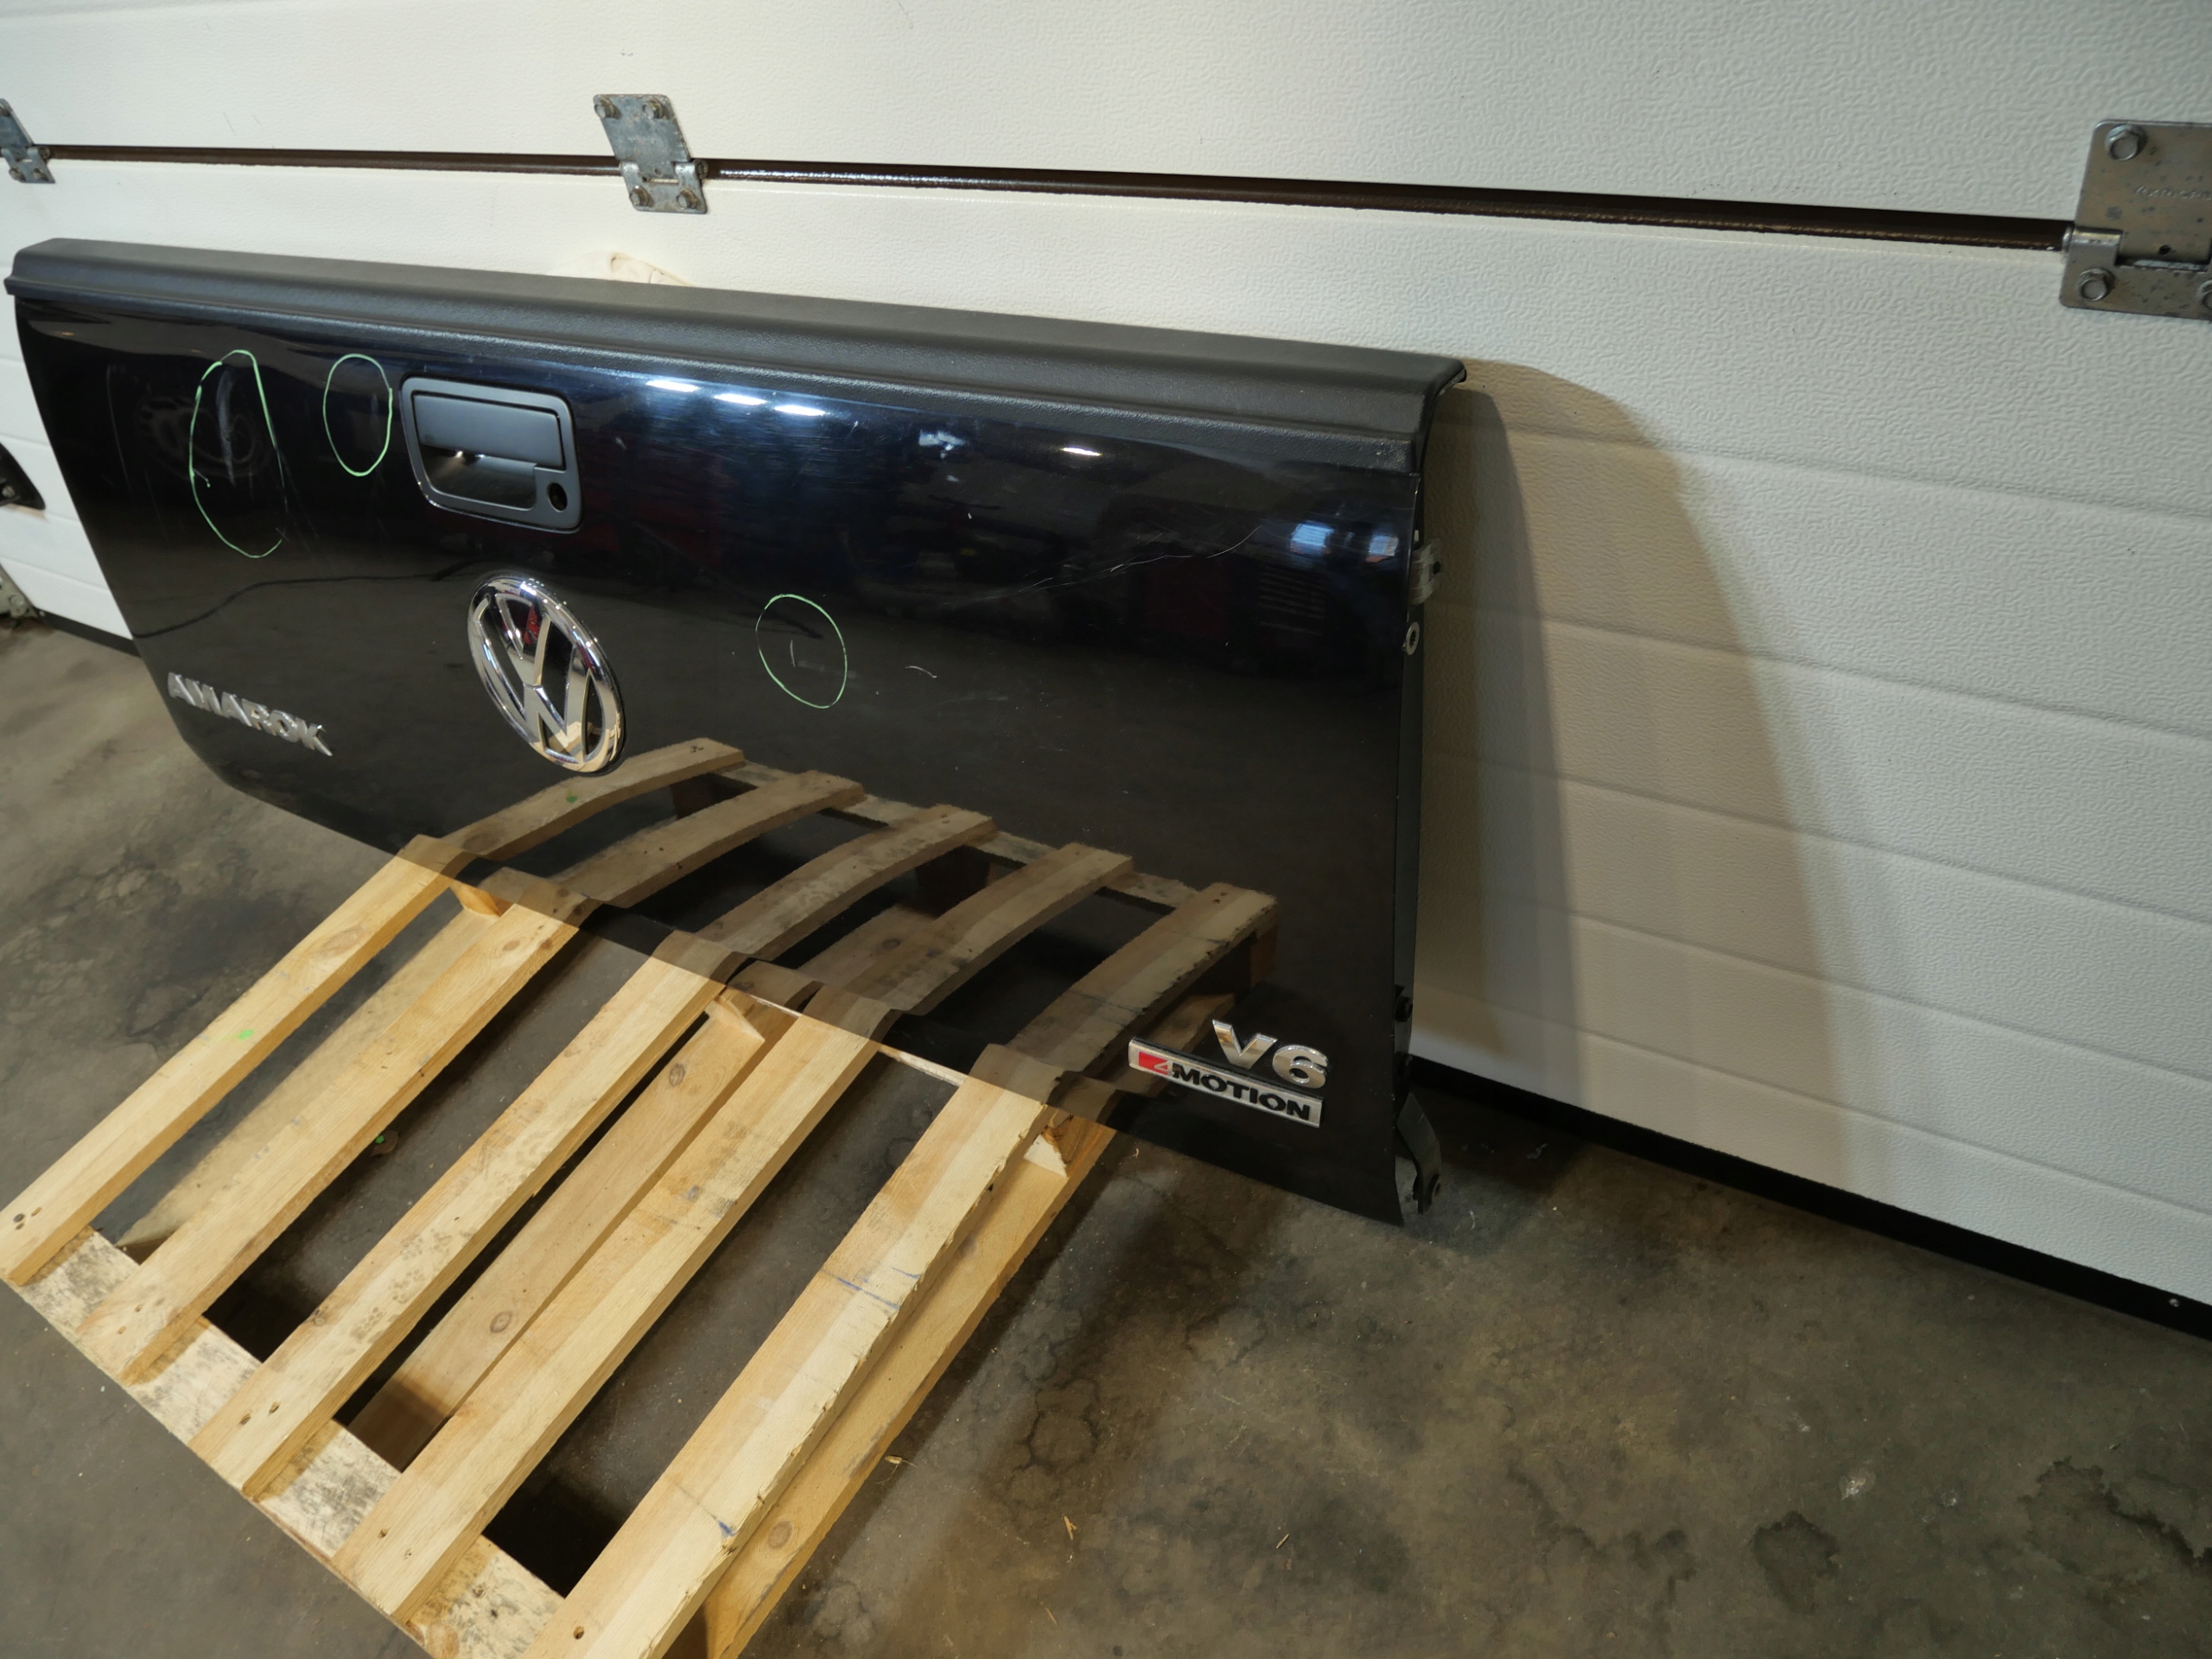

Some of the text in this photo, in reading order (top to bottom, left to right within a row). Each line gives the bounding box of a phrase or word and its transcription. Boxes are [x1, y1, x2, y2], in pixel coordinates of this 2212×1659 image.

[168, 672, 333, 757] AMAROK
[1139, 1052, 1310, 1121] 4MOTION
[1212, 1020, 1329, 1090] V6
